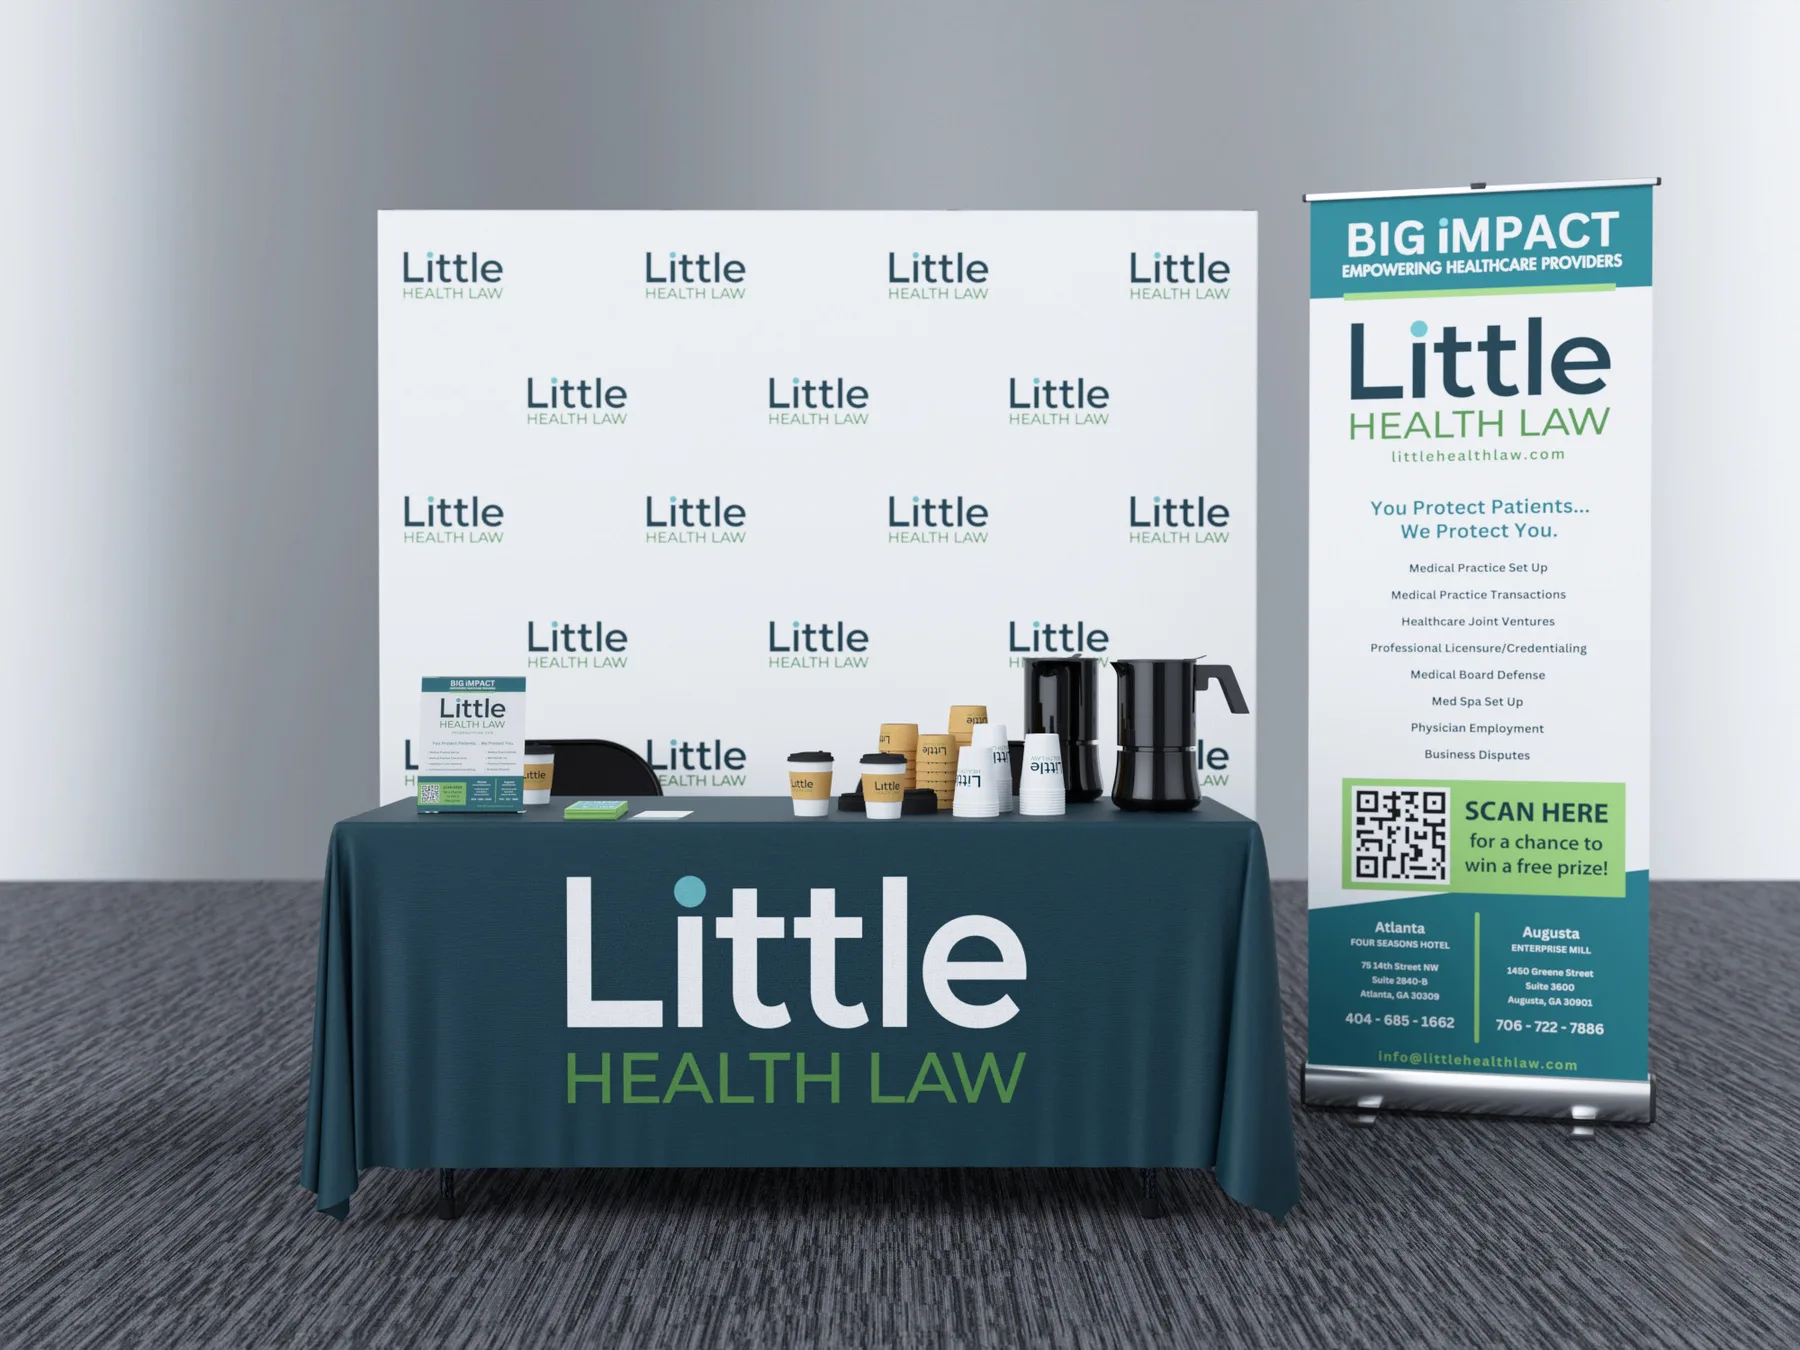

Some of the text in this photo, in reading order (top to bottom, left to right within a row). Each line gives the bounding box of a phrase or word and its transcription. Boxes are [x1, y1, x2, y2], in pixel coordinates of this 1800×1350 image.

[1348, 211, 1619, 257] BIG iMPACT
[404, 252, 503, 283] Little
[646, 252, 745, 283] Little
[889, 252, 988, 283] Little
[1131, 252, 1230, 283] Little
[1342, 254, 1622, 278] EMPOWERING HEALTHCARE PROVIDERS
[403, 288, 503, 299] HEALTH LAW
[646, 288, 745, 299] HEALTH LAW
[889, 288, 988, 299] HEALTH LAW
[1131, 288, 1230, 299] HEALTH LAW
[1351, 317, 1611, 400] Little
[528, 378, 627, 408] Little
[770, 378, 868, 408] Little
[1010, 378, 1109, 408] Little
[528, 413, 627, 424] HEALTH LAW
[769, 413, 868, 425] HEALTH LAW
[1010, 413, 1109, 425] HEALTH LAW
[1351, 407, 1610, 440] HEALTH LAW
[1392, 449, 1564, 462] littlehealthlaw.com
[405, 496, 503, 527] Little
[647, 496, 746, 527] Little
[889, 496, 988, 527] Little
[1131, 496, 1229, 527] Little
[1371, 498, 1589, 515] You Protect Patients...
[1401, 523, 1557, 538] We Protect You.
[404, 532, 503, 543] HEALTH LAW
[647, 532, 746, 543] HEALTH LAW
[889, 532, 988, 543] HEALTH LAW
[1130, 532, 1229, 543] HEALTH LAW
[1410, 563, 1548, 574] Medical Practice Set Up
[1392, 590, 1566, 599] Medical Practice Transactions
[1402, 617, 1555, 626] Healthcare Joint Ventures
[529, 621, 627, 652] Little
[770, 621, 868, 652] Little
[1010, 621, 1109, 652] Little
[1371, 643, 1587, 655] Professional Licensure/Credentialing
[528, 657, 627, 668] HEALTH LAW
[769, 657, 869, 668] HEALTH LAW
[1411, 670, 1545, 680] Medical Board Defense
[441, 698, 505, 718] Little
[1432, 697, 1523, 708] Med Spa Set Up
[1412, 723, 1544, 735] Physician Employment
[647, 739, 746, 770] Little
[922, 747, 946, 755] Little
[1425, 750, 1530, 762] Business Disputes
[659, 774, 746, 786] EALTH LAW
[791, 779, 813, 788] Little
[875, 781, 900, 791] Little
[1466, 801, 1608, 823] SCAN HERE
[1470, 833, 1602, 851] for a chance to
[1465, 858, 1607, 878] win a free prize!
[1375, 922, 1425, 934] Atlanta
[1523, 927, 1580, 941] Augusta
[1351, 938, 1450, 949] FOUR SEASONS HOTEL
[1512, 944, 1591, 954] ENTERPRISE MILL
[566, 876, 1027, 1029] Little
[1361, 961, 1371, 969] 75
[1394, 963, 1421, 971] Street
[1507, 967, 1594, 977] 1450 Greene Street
[1372, 976, 1428, 985] Suite 2840-B
[1526, 982, 1575, 991] Suite 3600
[1360, 990, 1440, 1000] Atlanta, GA 30309
[1508, 996, 1593, 1007] Augusta, GA 30901
[1345, 1013, 1372, 1024] 404
[1384, 1014, 1409, 1026] 685
[1421, 1016, 1454, 1028] 1662
[1496, 1019, 1522, 1031] 706
[1534, 1021, 1557, 1033] 722
[1570, 1022, 1604, 1035] 7886
[1378, 1051, 1577, 1071] info@littlehealthlaw.com
[568, 1052, 1026, 1104] HEALTH LAW
